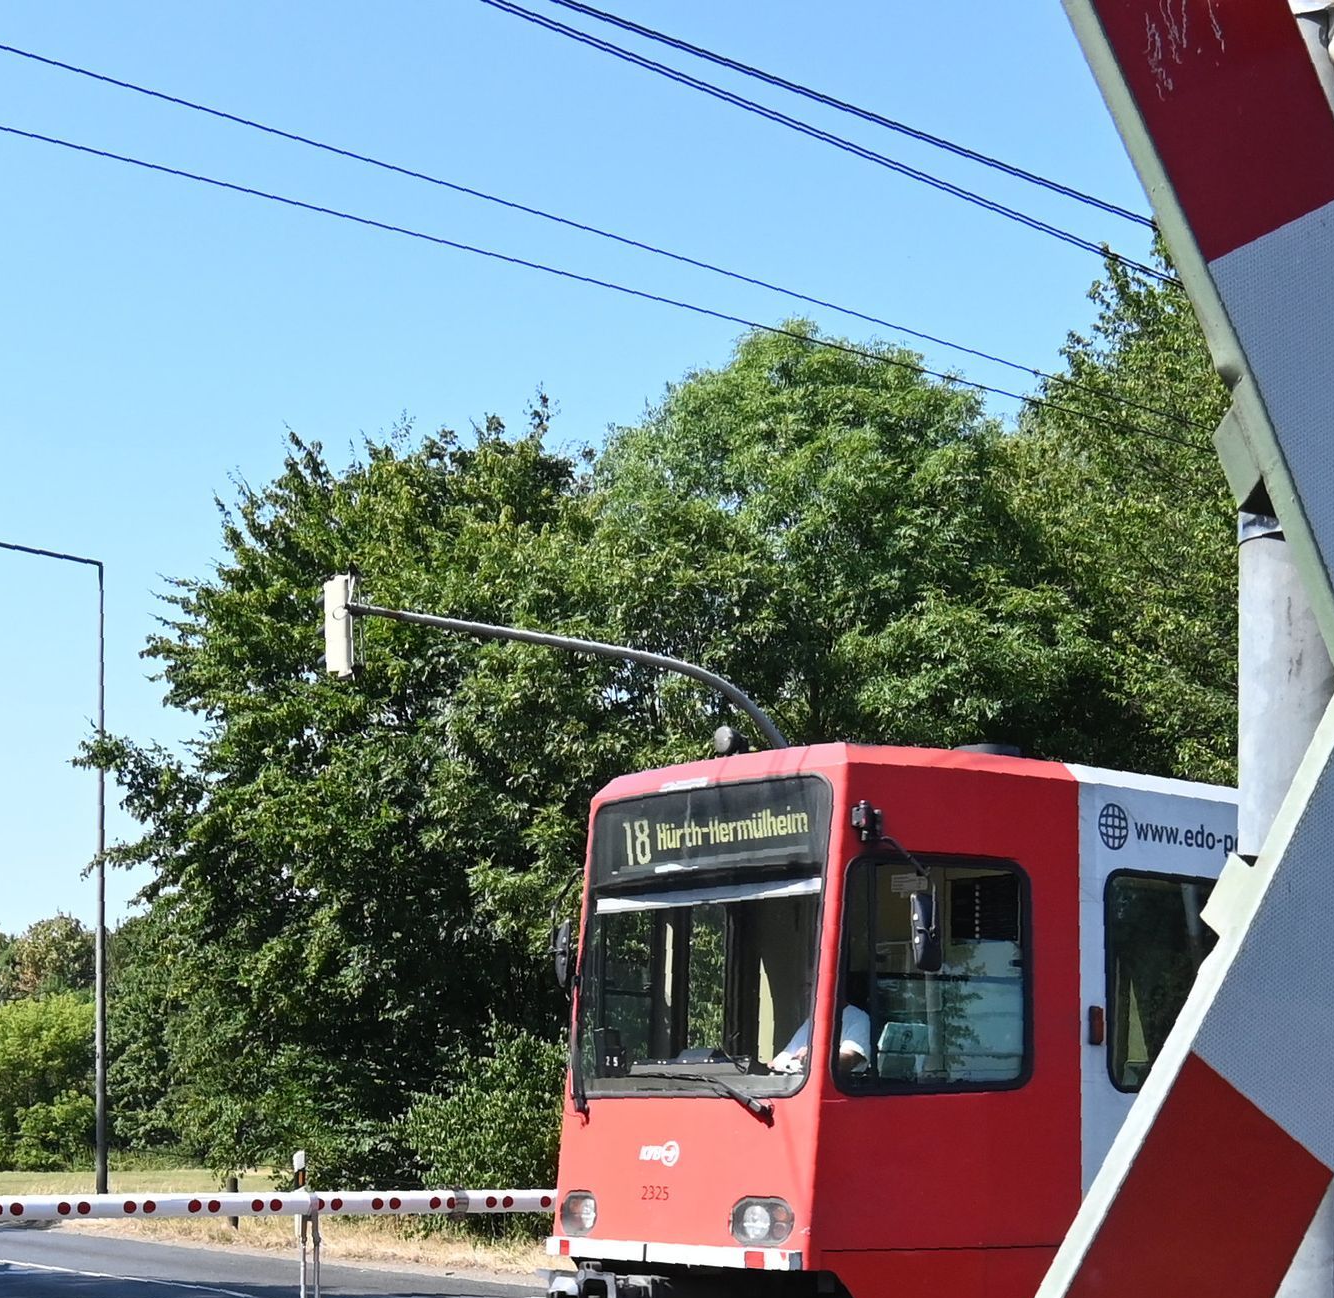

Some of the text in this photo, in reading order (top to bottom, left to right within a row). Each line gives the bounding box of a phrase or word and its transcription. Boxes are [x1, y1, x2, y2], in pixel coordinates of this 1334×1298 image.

[623, 806, 809, 866] 18 Hürth-Hermülheim
[641, 1185, 670, 1200] 2325
